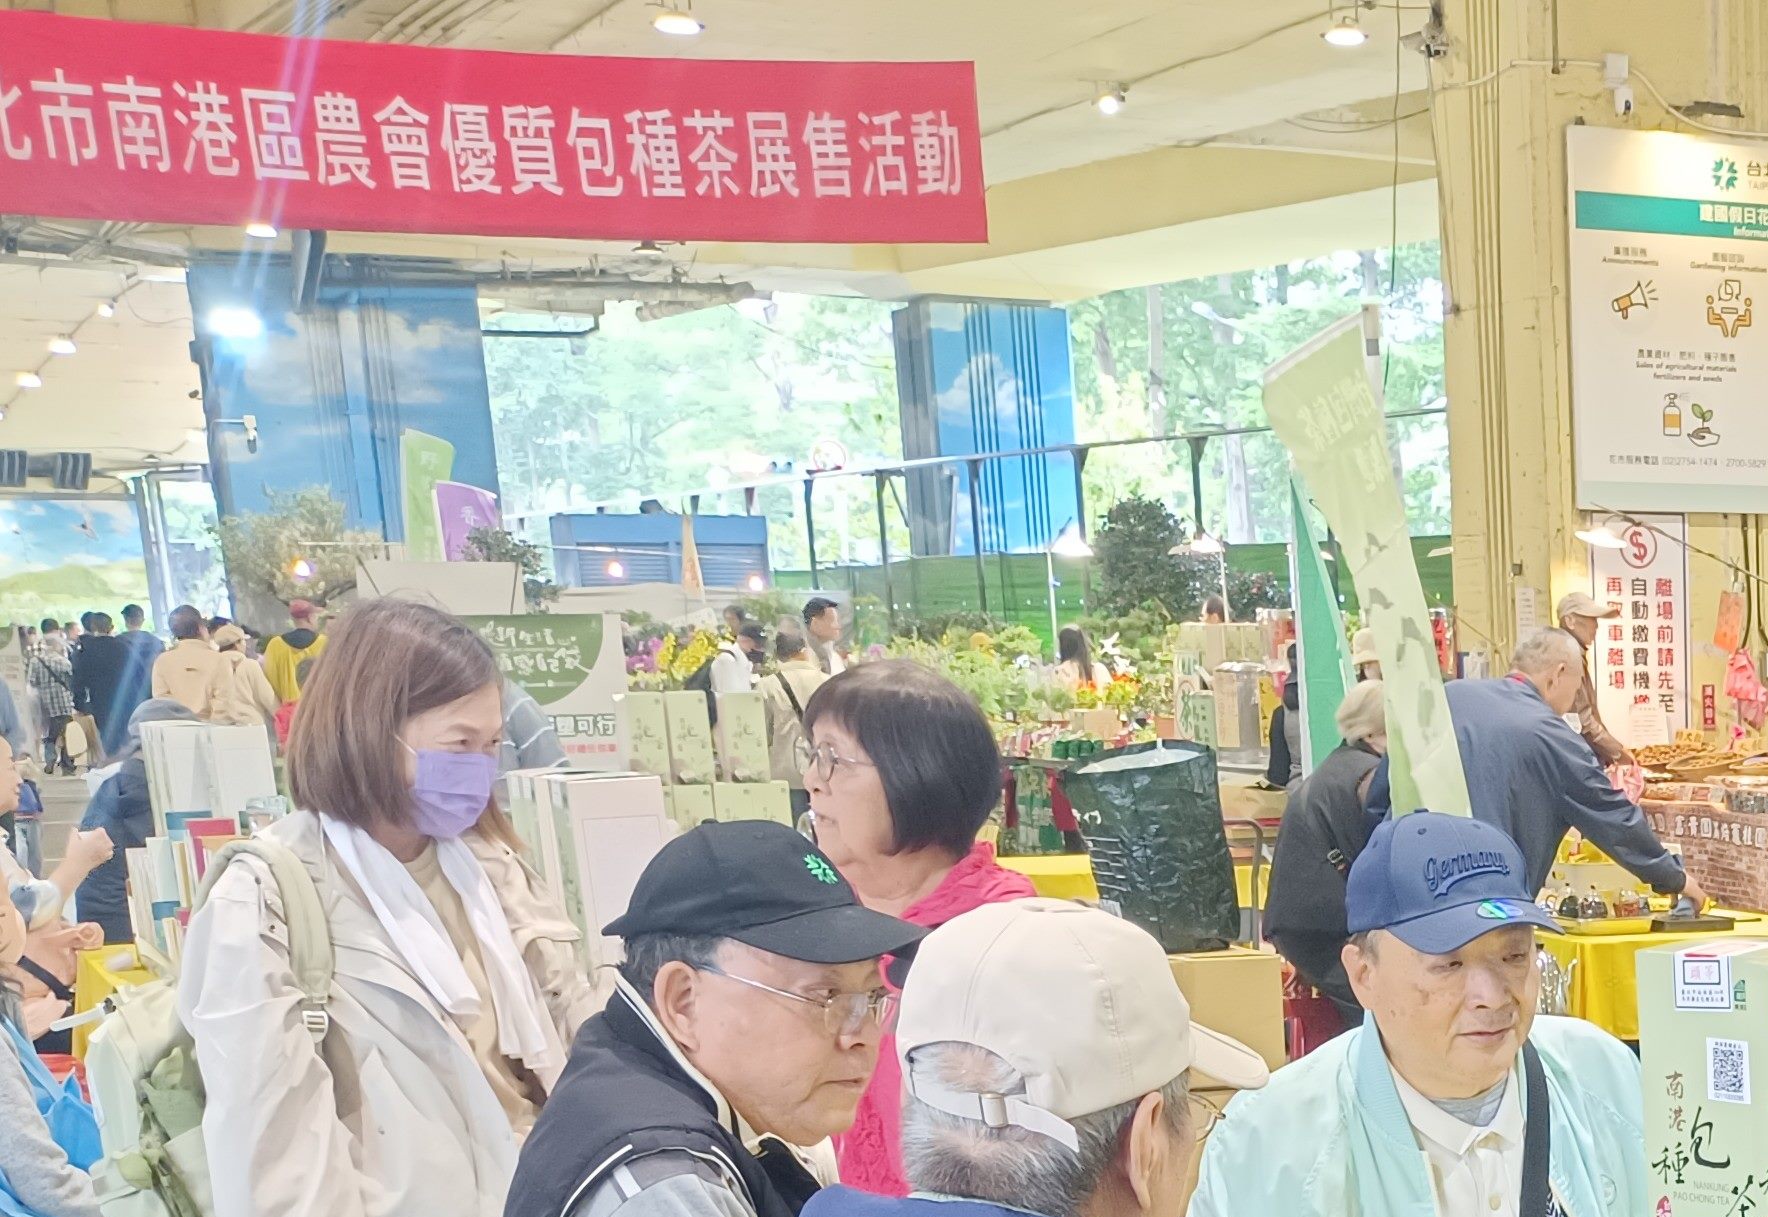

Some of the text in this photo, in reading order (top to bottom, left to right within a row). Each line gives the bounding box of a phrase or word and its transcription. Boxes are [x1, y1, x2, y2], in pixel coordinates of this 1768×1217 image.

[1636, 361, 1653, 369] Sales
[1655, 577, 1675, 714] 離場前請先至
[1423, 851, 1510, 892] Germany
[1665, 1071, 1687, 1131] 南港
